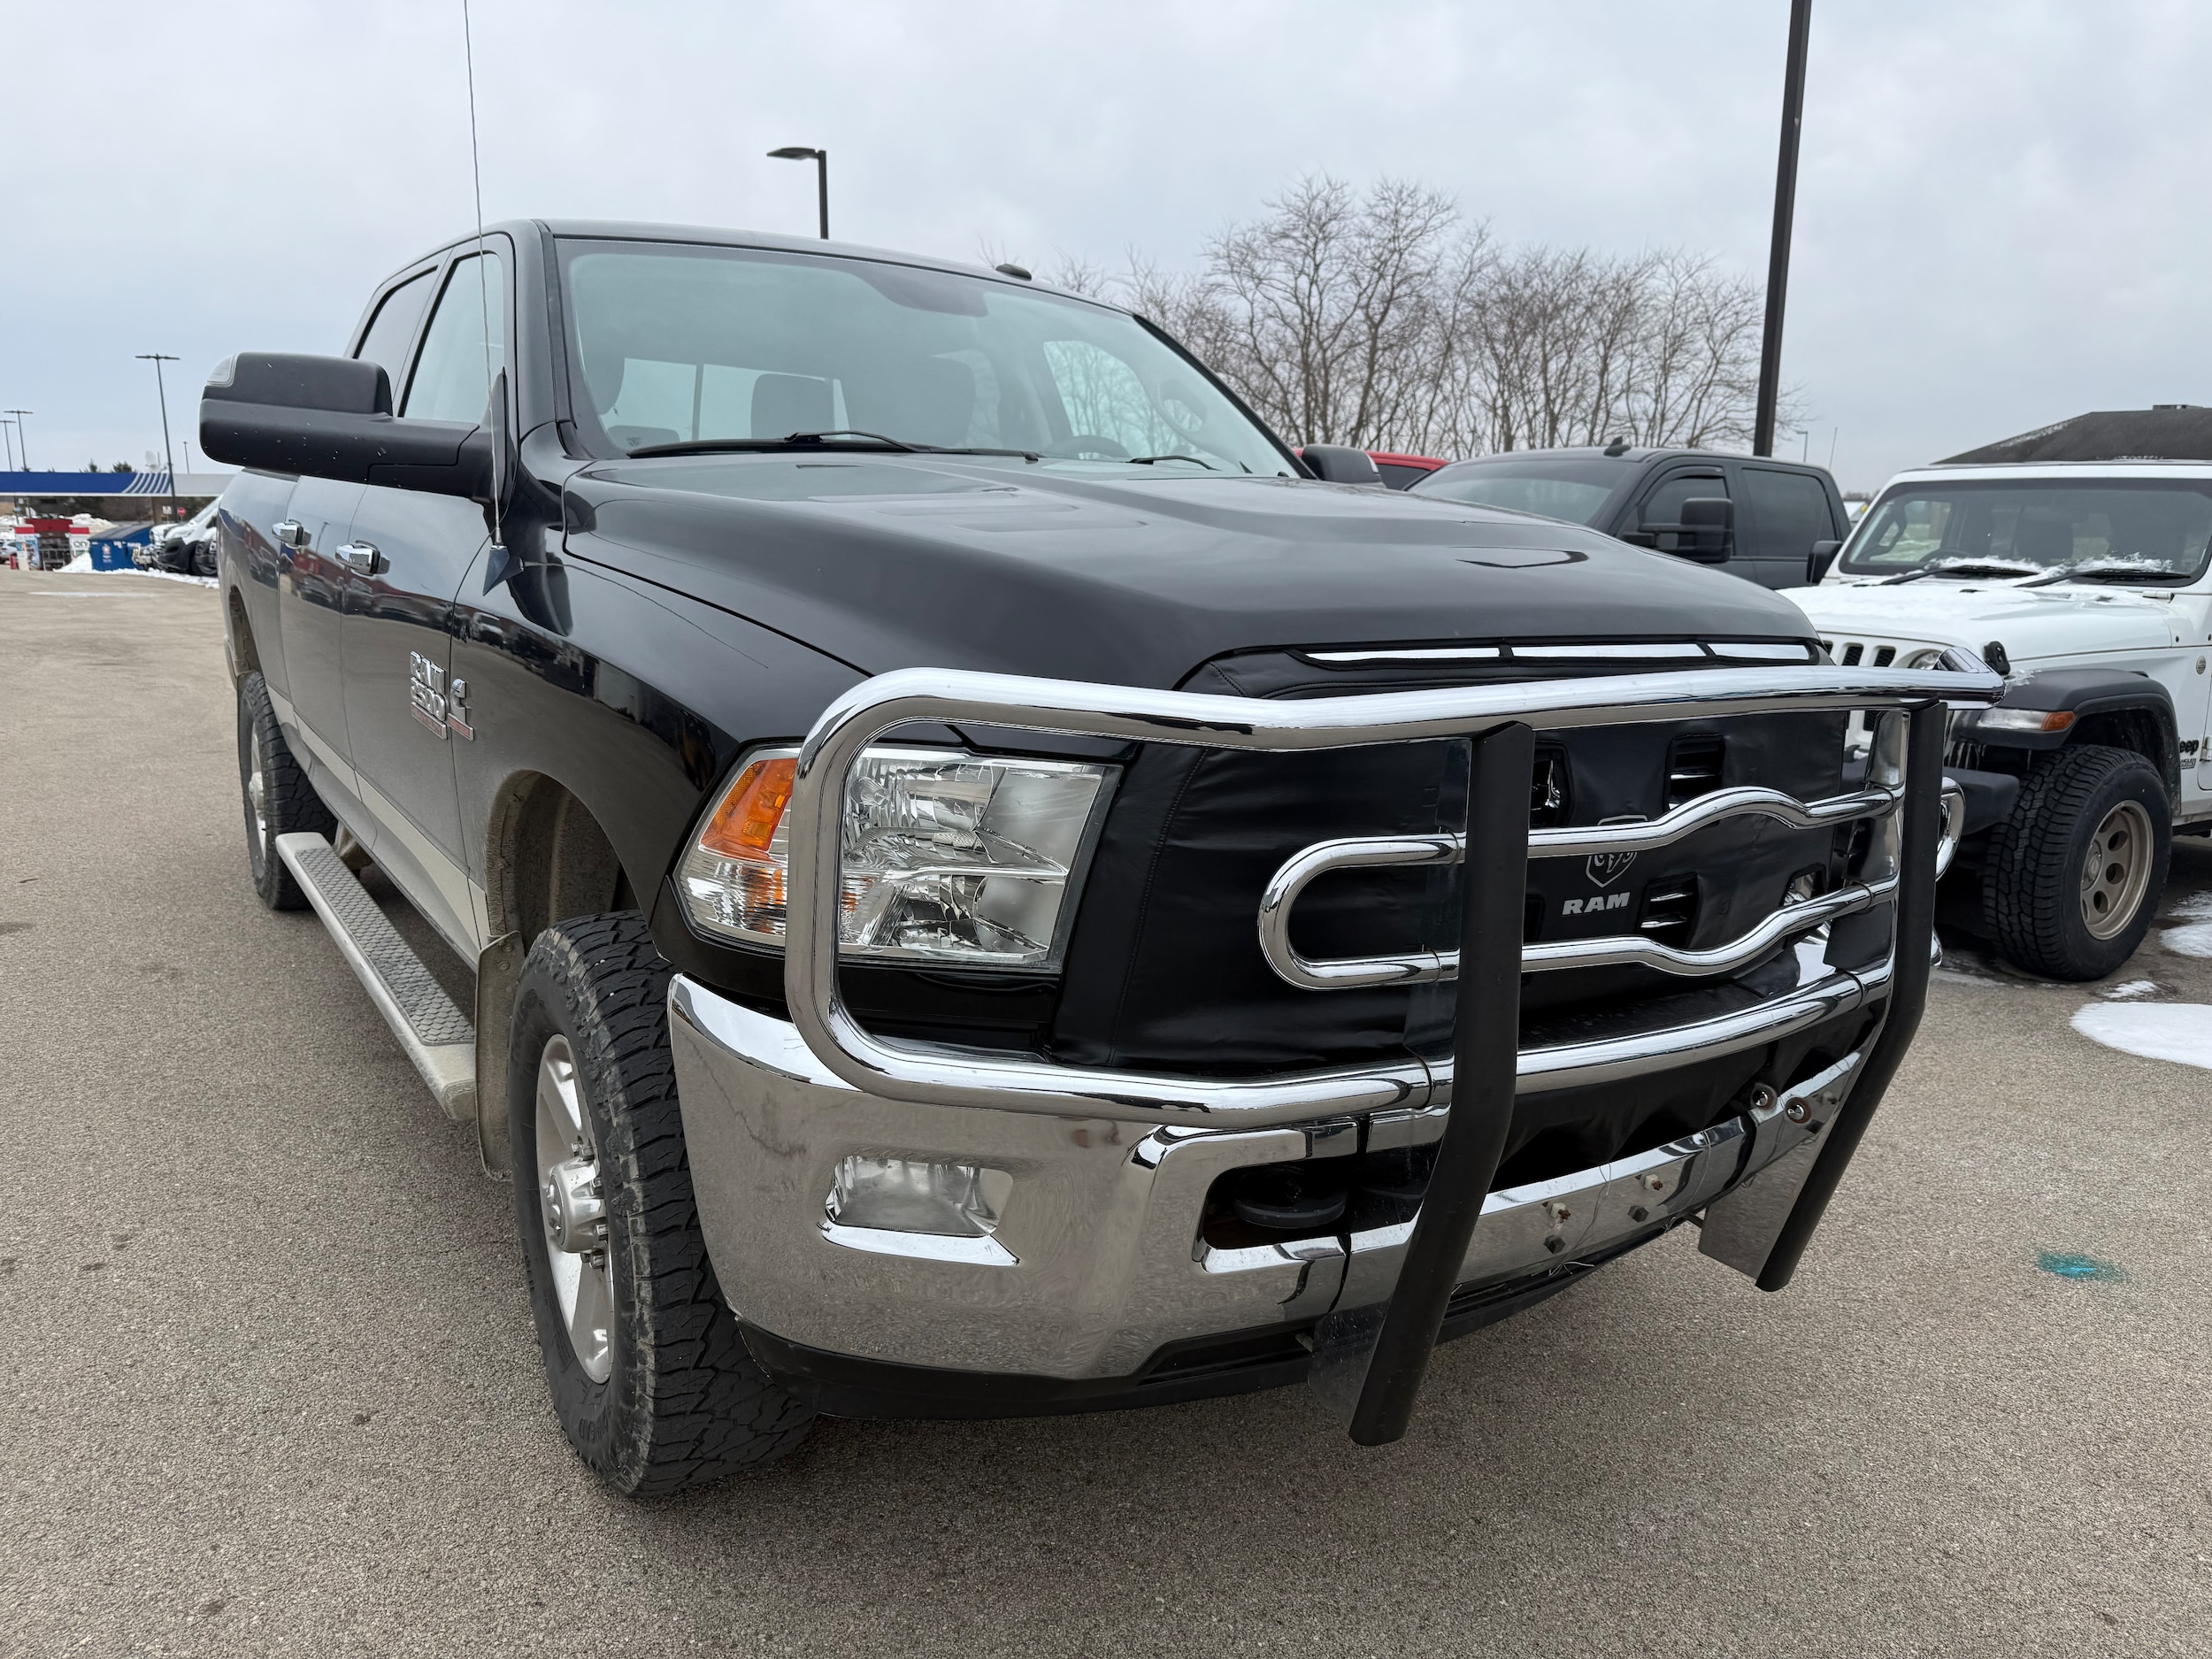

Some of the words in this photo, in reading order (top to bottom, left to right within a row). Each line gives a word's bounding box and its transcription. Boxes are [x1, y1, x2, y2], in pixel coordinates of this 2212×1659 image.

[411, 650, 446, 695] RAM
[2178, 737, 2200, 756] eep
[1562, 892, 1631, 915] RAM
